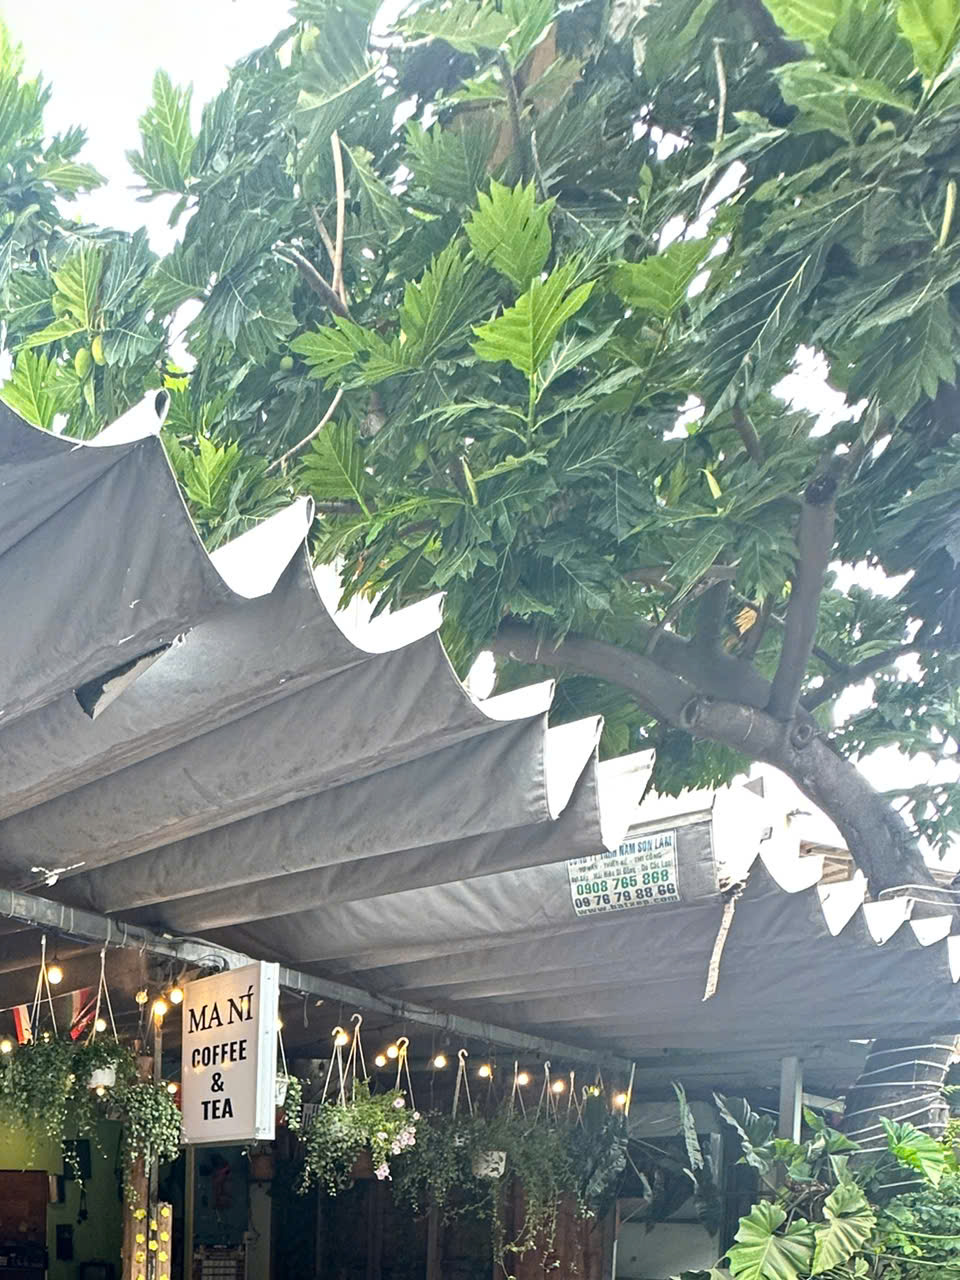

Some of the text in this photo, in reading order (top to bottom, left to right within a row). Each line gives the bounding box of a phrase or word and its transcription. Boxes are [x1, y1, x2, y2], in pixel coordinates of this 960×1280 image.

[576, 880, 608, 895] 0908
[612, 875, 637, 890] 765
[657, 883, 675, 895] 66
[188, 985, 254, 1034] MA NÍ
[192, 1039, 247, 1069] COFFEE
[211, 1072, 224, 1093] &
[201, 1098, 234, 1121] TEA
